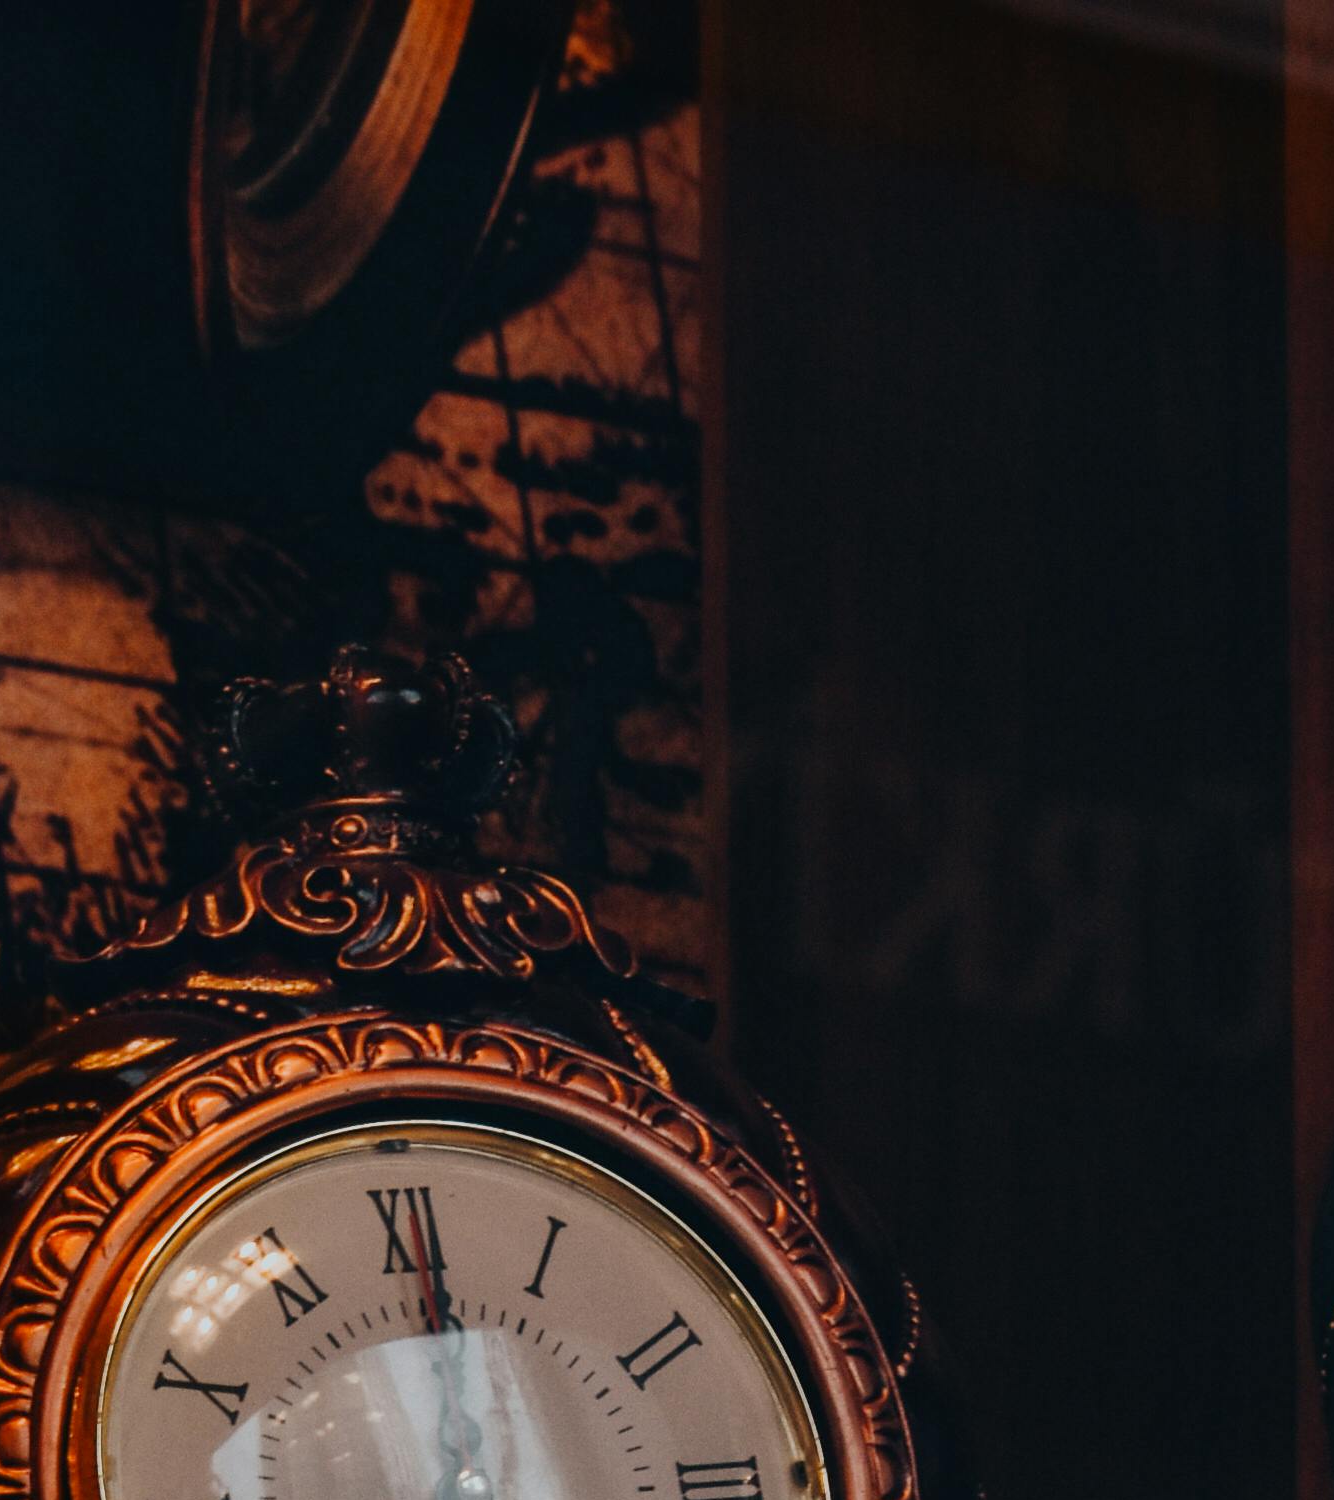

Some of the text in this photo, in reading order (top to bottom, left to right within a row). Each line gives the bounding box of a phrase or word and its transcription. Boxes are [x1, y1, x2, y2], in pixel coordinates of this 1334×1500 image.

[366, 1186, 448, 1277] XII
[523, 1215, 567, 1299] I
[152, 1349, 250, 1426] X
[616, 1310, 703, 1391] II
